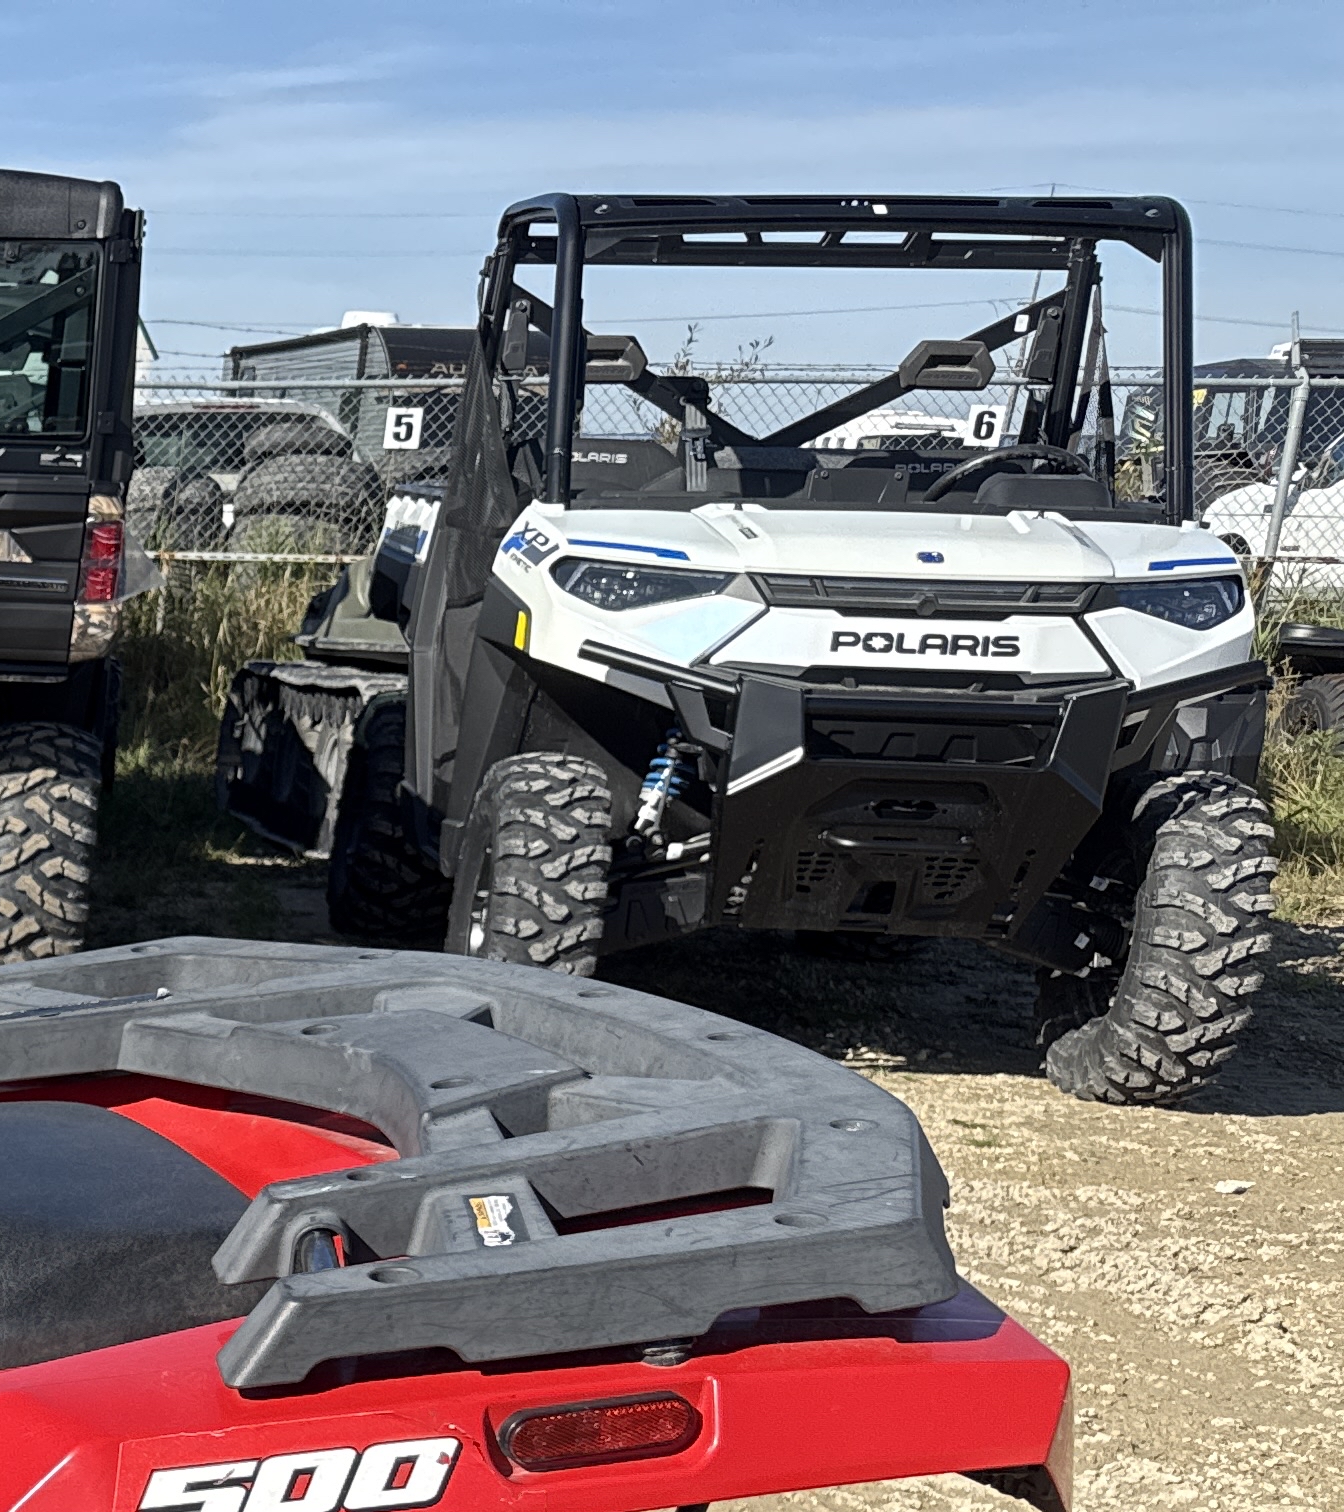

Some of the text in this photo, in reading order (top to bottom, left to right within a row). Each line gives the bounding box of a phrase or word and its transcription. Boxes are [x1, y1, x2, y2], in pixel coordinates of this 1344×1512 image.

[392, 413, 414, 442] 5
[973, 410, 997, 440] 6
[571, 451, 628, 464] OLARIS
[895, 463, 958, 473] POLAR
[829, 630, 1022, 658] POLARIS
